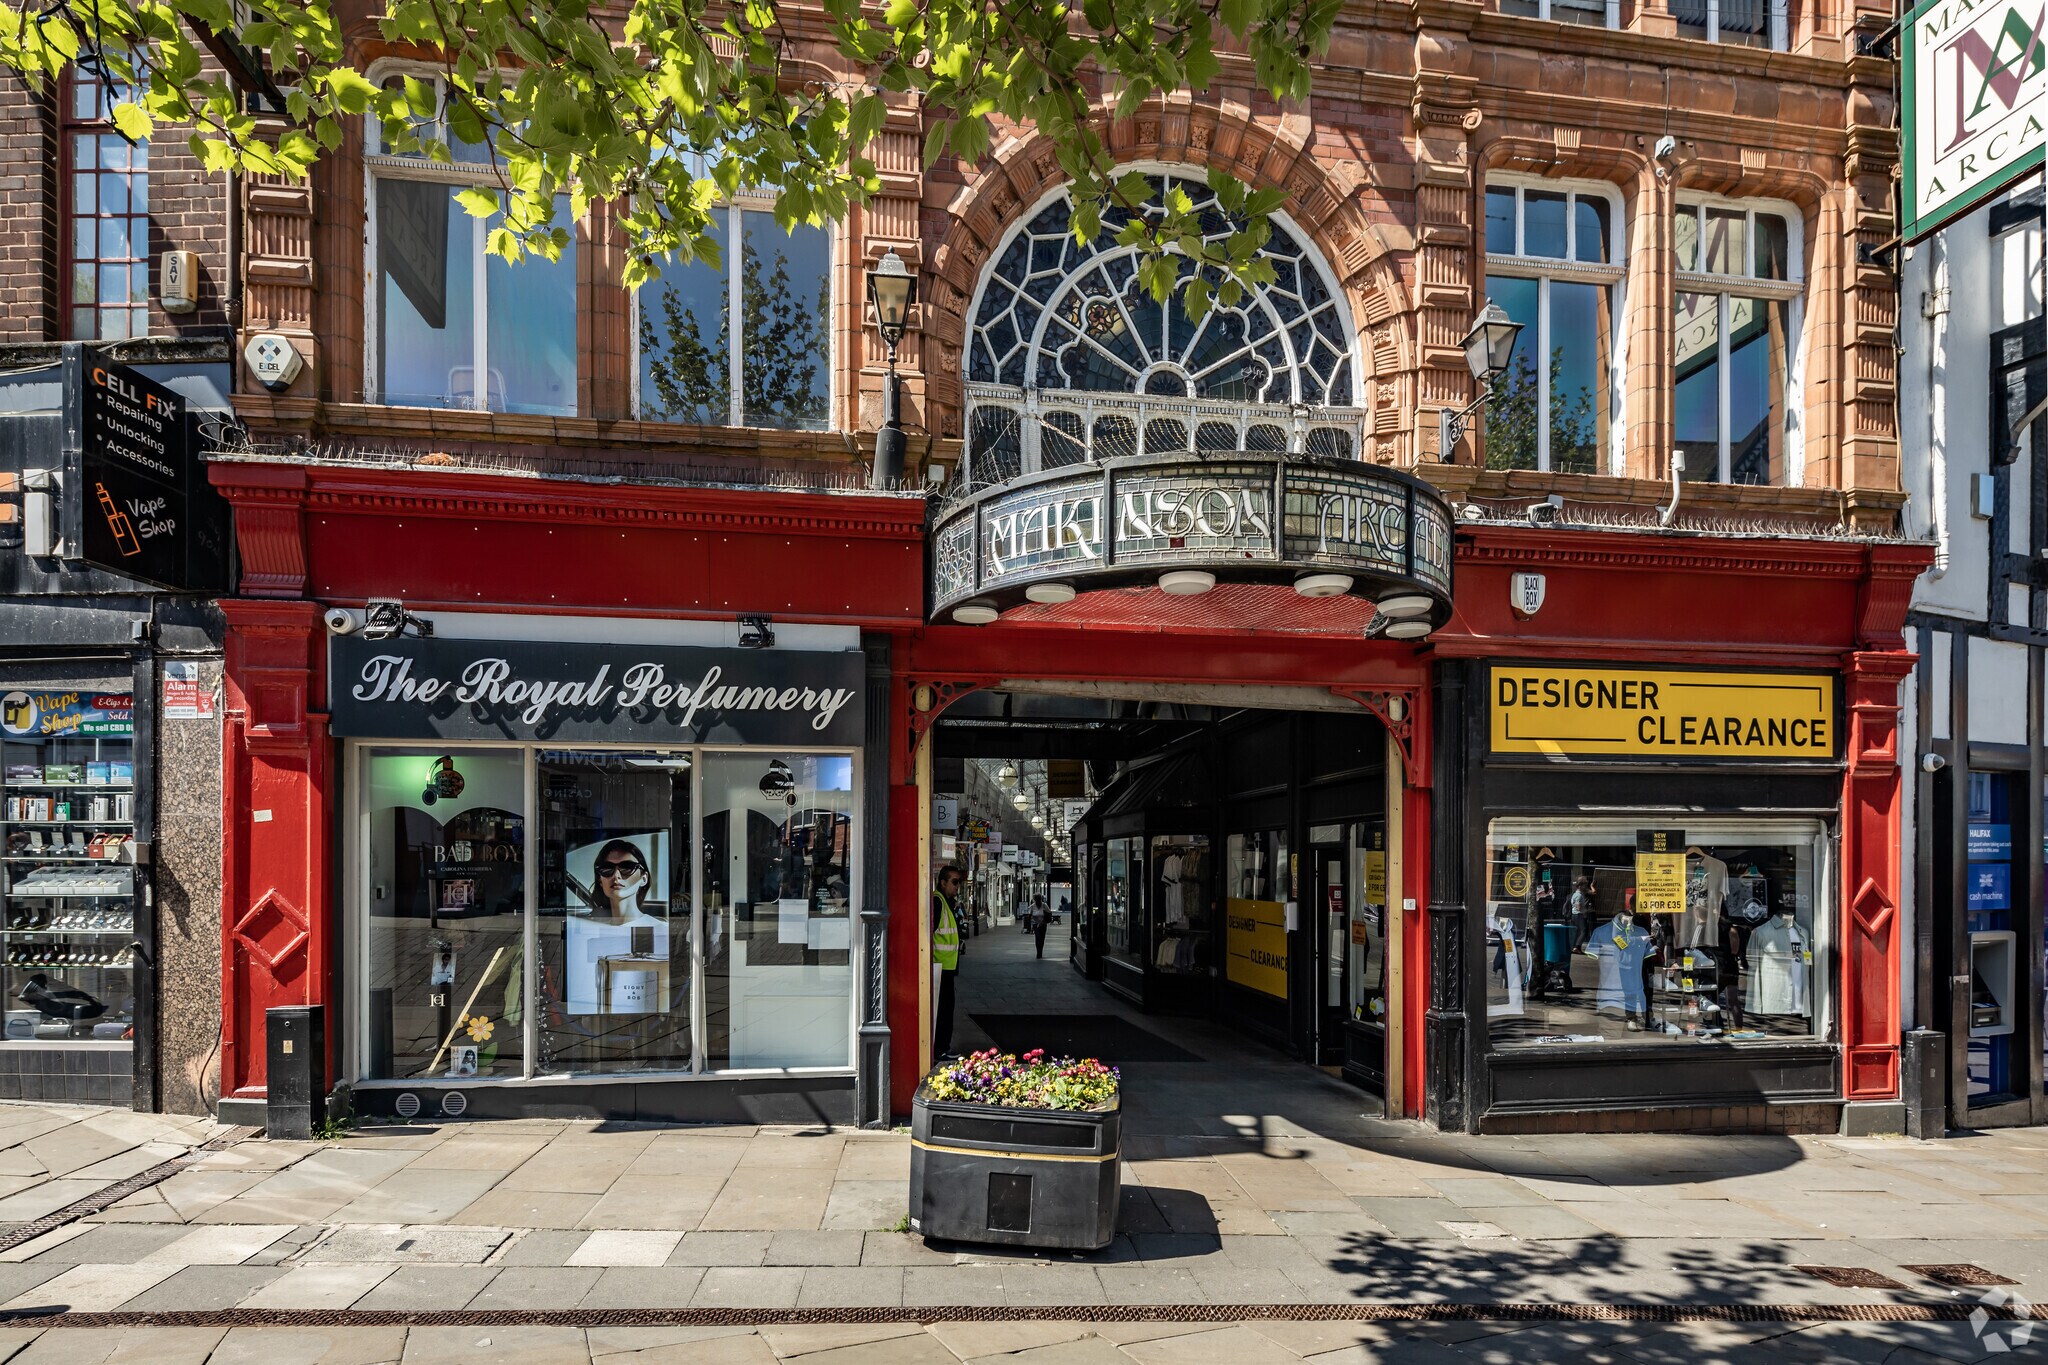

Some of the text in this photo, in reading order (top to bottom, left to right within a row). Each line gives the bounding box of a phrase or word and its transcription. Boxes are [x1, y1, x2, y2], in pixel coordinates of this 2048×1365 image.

[1924, 0, 1983, 46] MA
[1925, 114, 2045, 204] ARCA
[92, 367, 141, 404] CELL
[107, 395, 163, 433] Repairing
[107, 416, 165, 454] Unlocking
[107, 440, 175, 477] Accessories
[126, 497, 167, 518] Vape
[139, 518, 176, 539] Shop
[988, 486, 1272, 576] MAKINSON
[1525, 577, 1539, 590] BLACK
[1526, 591, 1538, 605] BOX
[167, 681, 196, 690] Alarm
[352, 655, 856, 730] The Royal Perfumery
[1498, 677, 1659, 710] DESIGNER
[35, 692, 80, 713] Vape
[98, 697, 121, 708] E-Cigs
[42, 712, 82, 734] Shop
[107, 711, 128, 720] Sold
[1637, 715, 1827, 747] CLEARANCE
[1969, 829, 1991, 838] HALIFAX
[482, 845, 521, 863] BOY
[1643, 901, 1648, 909] 3
[1650, 901, 1665, 909] FOR
[1667, 901, 1681, 909] £35
[1969, 891, 2003, 900] cash machine
[1228, 914, 1255, 933] DESIGNER
